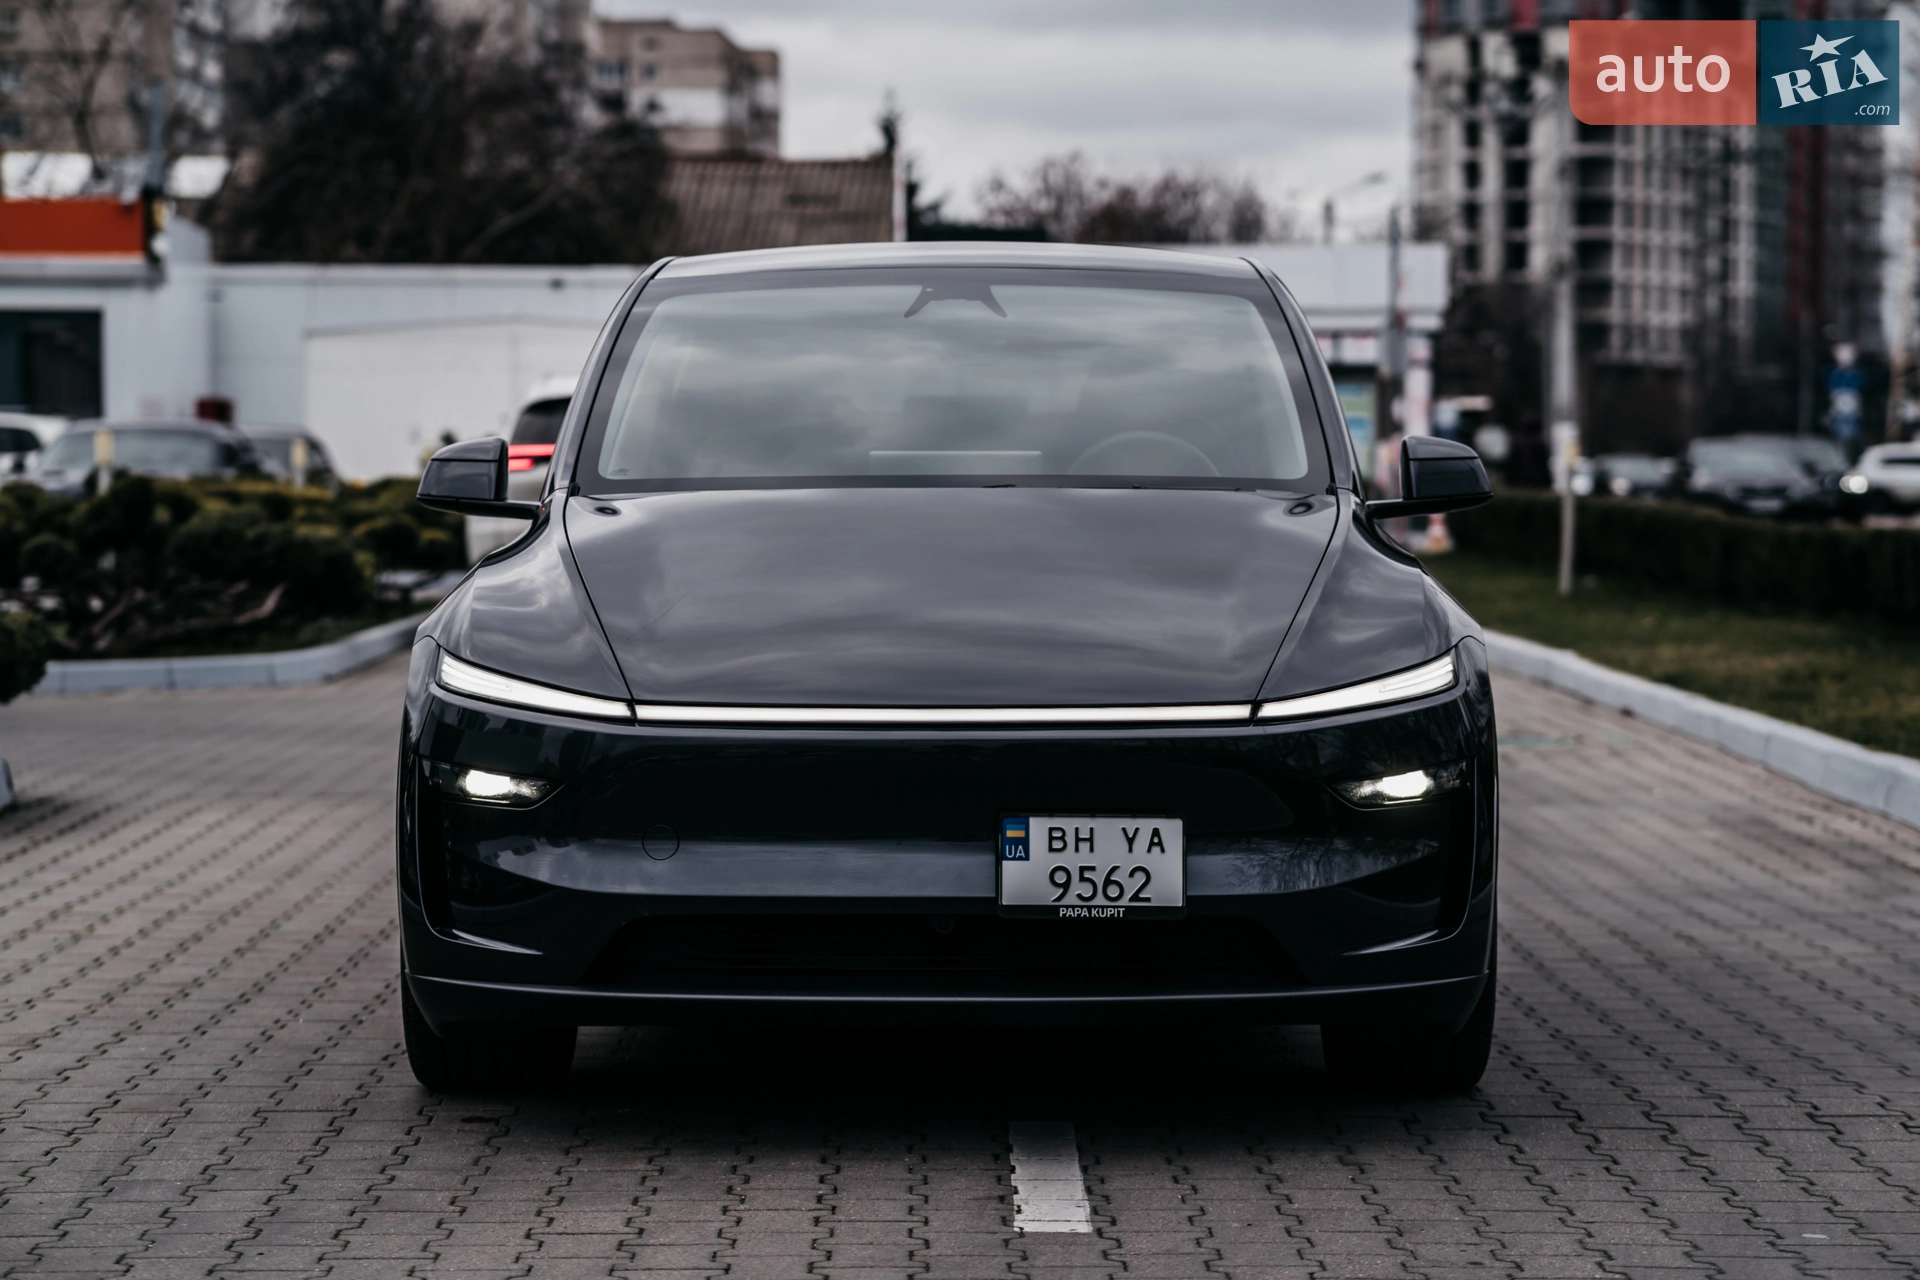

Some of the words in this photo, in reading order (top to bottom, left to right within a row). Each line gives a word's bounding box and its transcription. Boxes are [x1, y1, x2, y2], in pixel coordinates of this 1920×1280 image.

[1048, 826, 1094, 853] BH
[1121, 826, 1166, 853] YA
[1005, 845, 1026, 858] UA
[1048, 865, 1152, 903] 9562
[1059, 907, 1089, 918] PAPA
[1091, 907, 1126, 918] KUPIT
